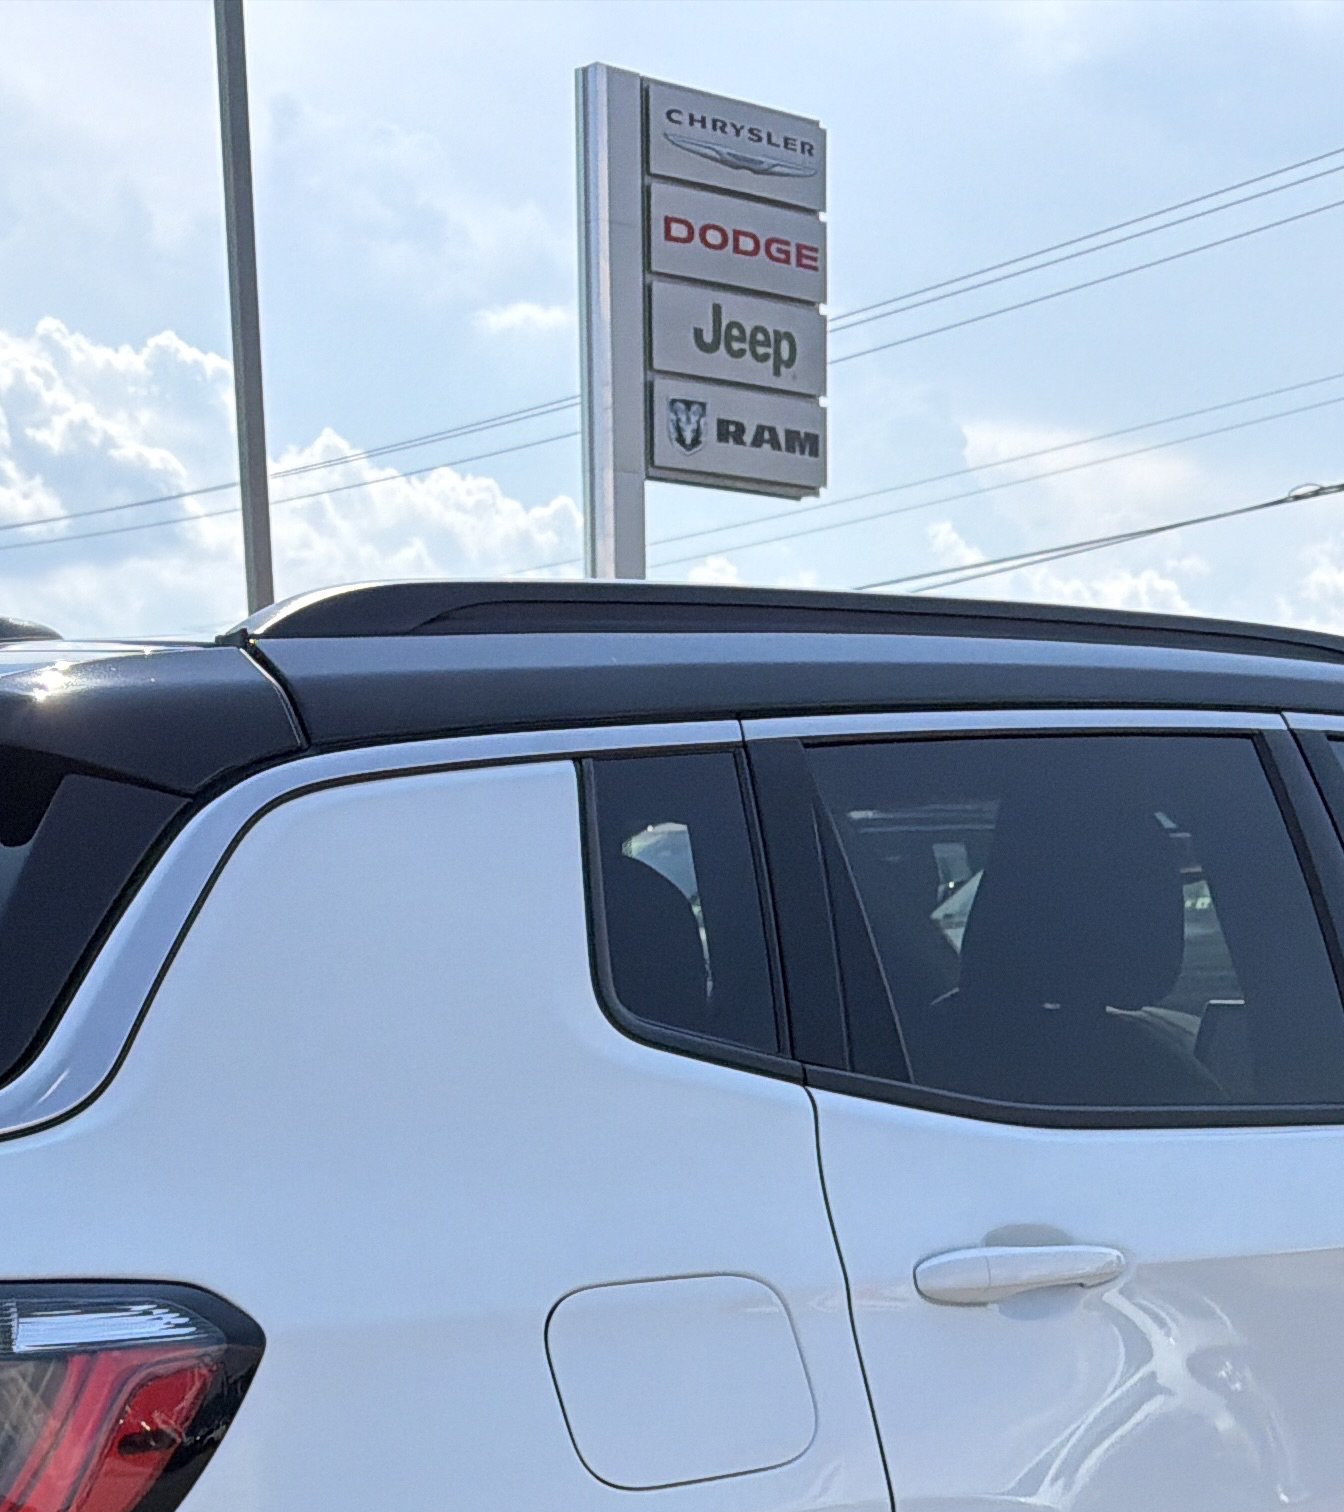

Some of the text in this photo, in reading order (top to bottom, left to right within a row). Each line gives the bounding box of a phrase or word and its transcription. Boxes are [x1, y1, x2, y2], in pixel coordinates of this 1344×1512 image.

[665, 109, 814, 157] CHRYSLER
[664, 215, 820, 271] DODGE
[693, 302, 797, 376] Jeep
[716, 417, 820, 458] RAM
